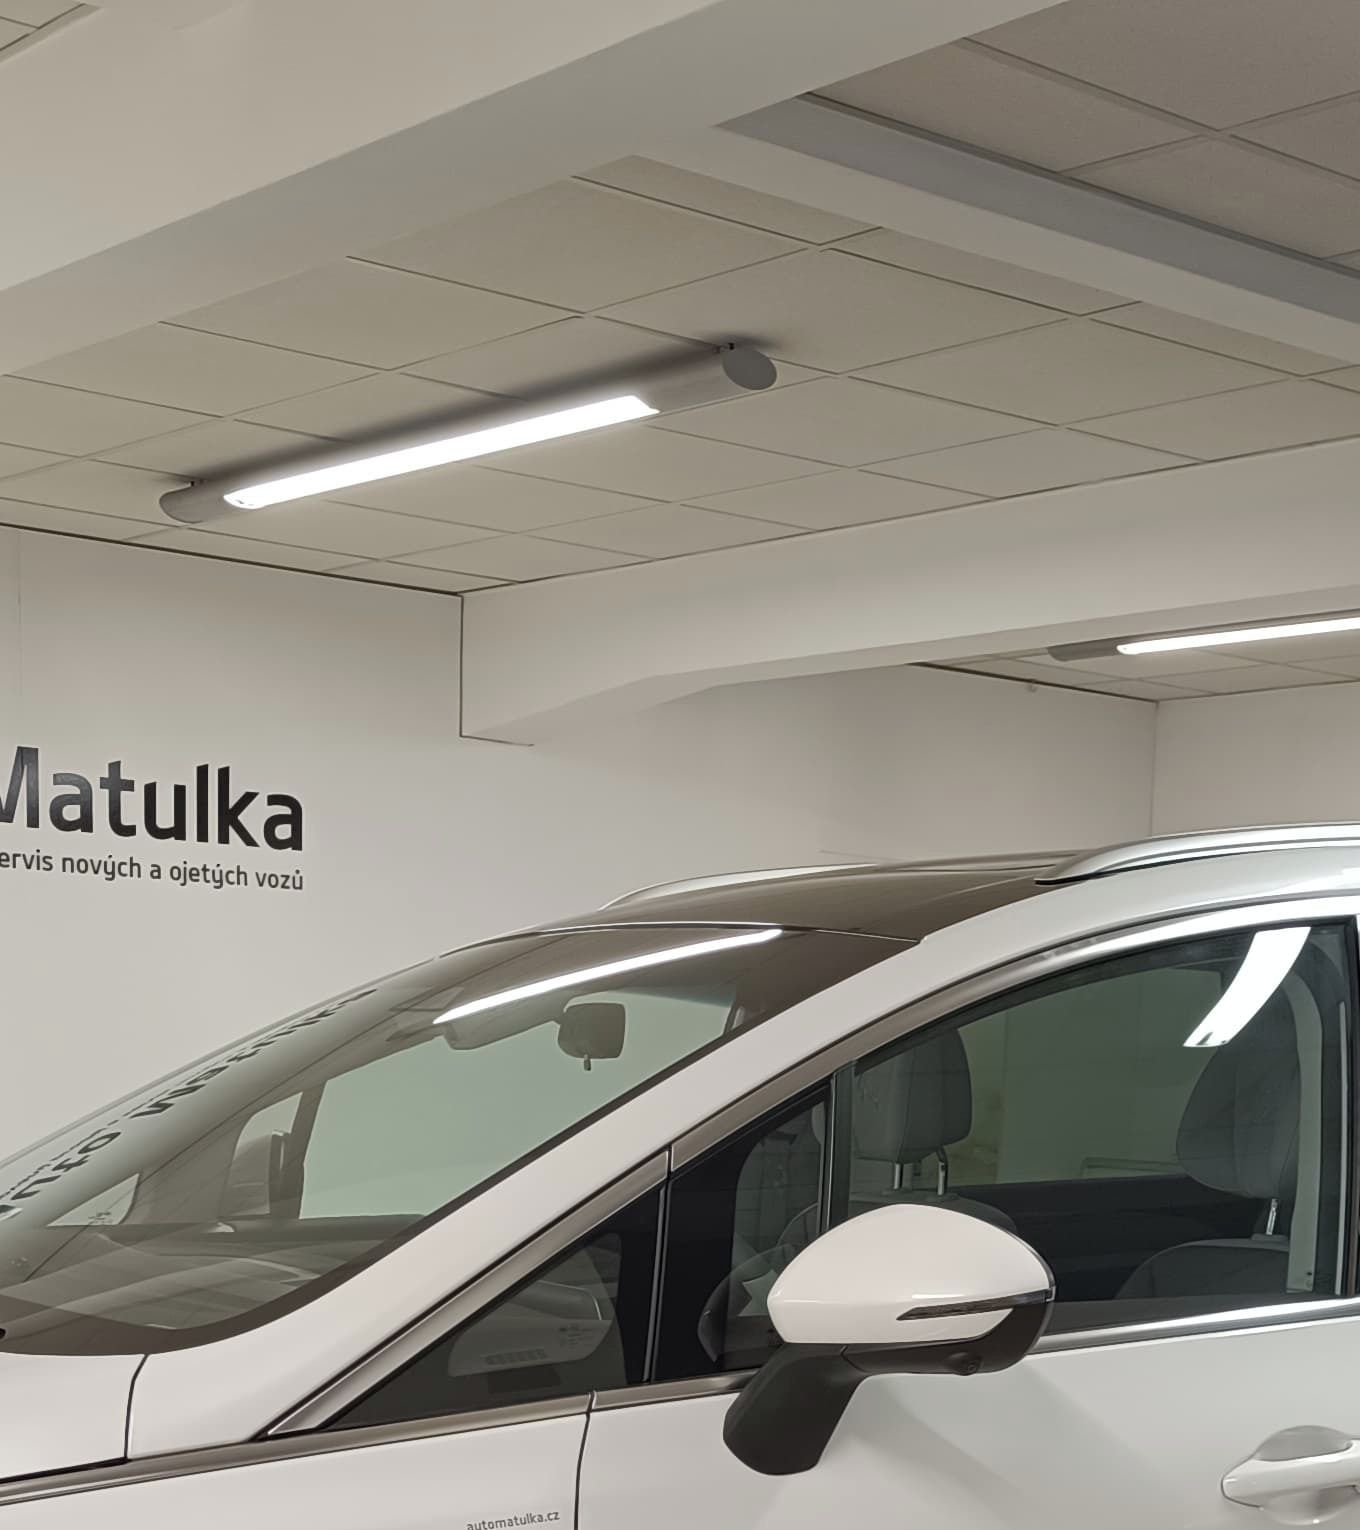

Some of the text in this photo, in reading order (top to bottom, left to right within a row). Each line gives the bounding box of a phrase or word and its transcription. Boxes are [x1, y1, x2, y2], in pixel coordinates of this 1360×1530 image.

[61, 854, 142, 882] nových
[149, 863, 162, 880] a
[169, 862, 248, 890] ojetých
[255, 868, 303, 891] vozů
